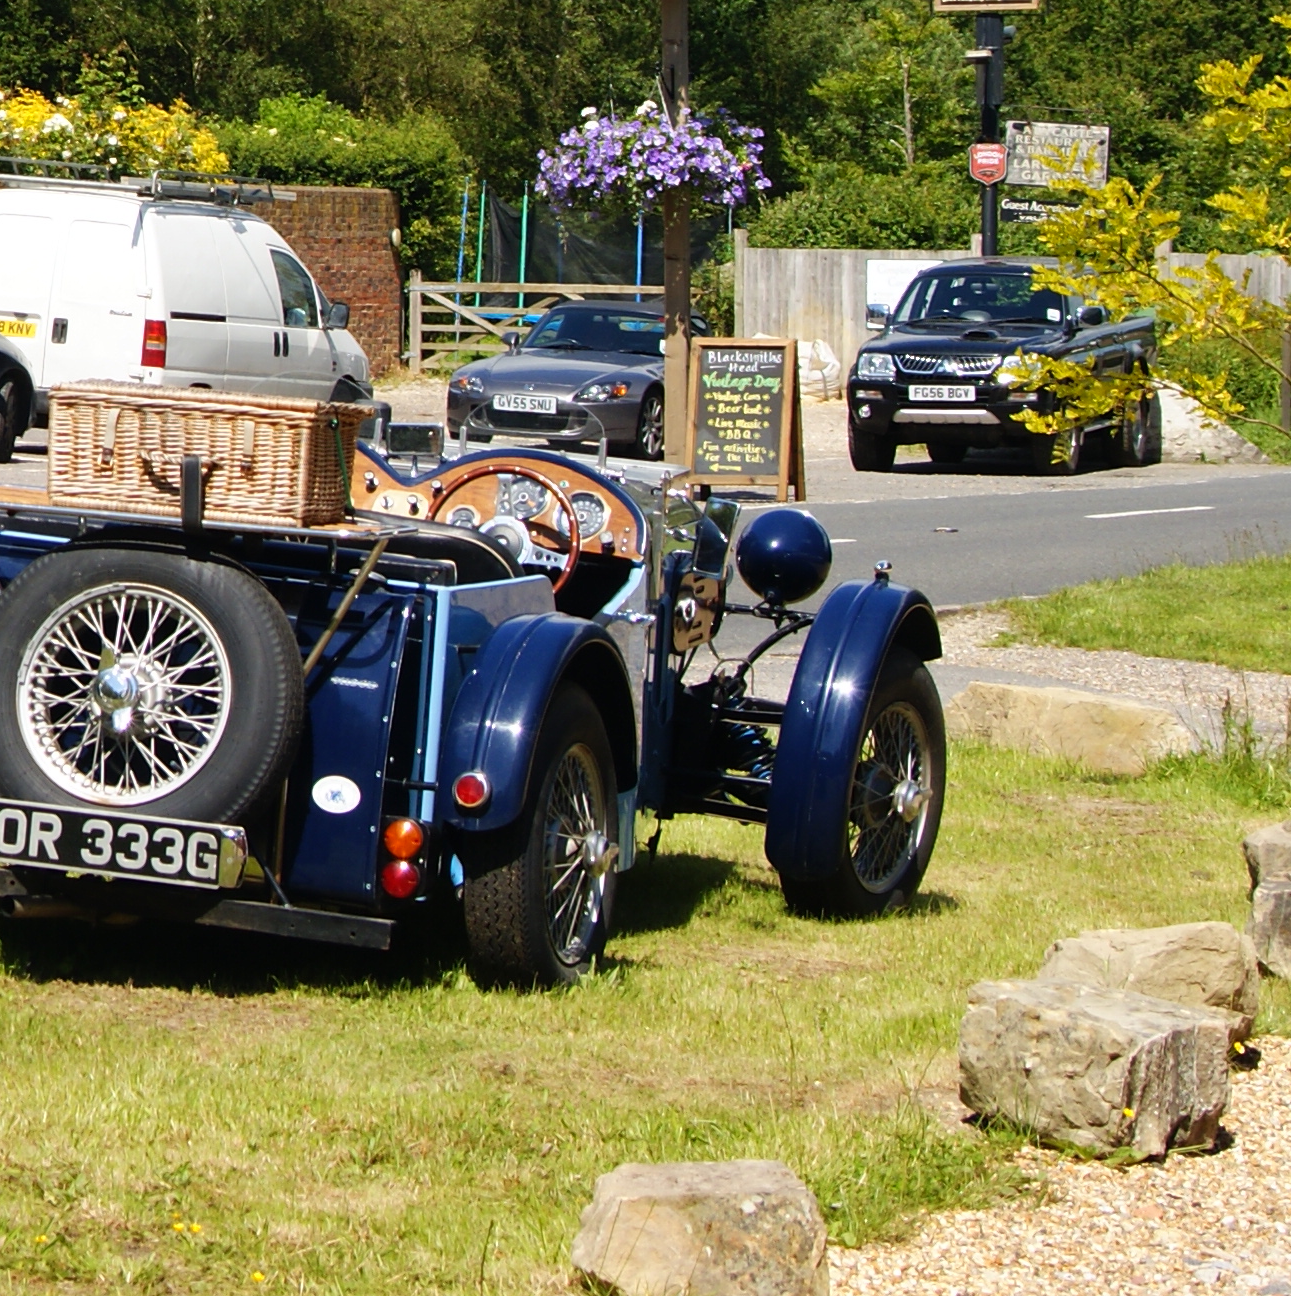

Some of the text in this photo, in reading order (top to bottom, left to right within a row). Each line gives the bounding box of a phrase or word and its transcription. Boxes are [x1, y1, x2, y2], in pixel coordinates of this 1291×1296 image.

[1001, 198, 1030, 211] Guest
[8, 321, 32, 335] KNV
[707, 350, 782, 364] Blacksmiths
[728, 361, 758, 372] Head
[702, 371, 781, 394] Vintage Day
[913, 387, 971, 399] FG56 BGV
[530, 398, 552, 412] SNU
[718, 403, 742, 414] Beer
[715, 417, 734, 428] Live
[80, 818, 219, 881] 333G
